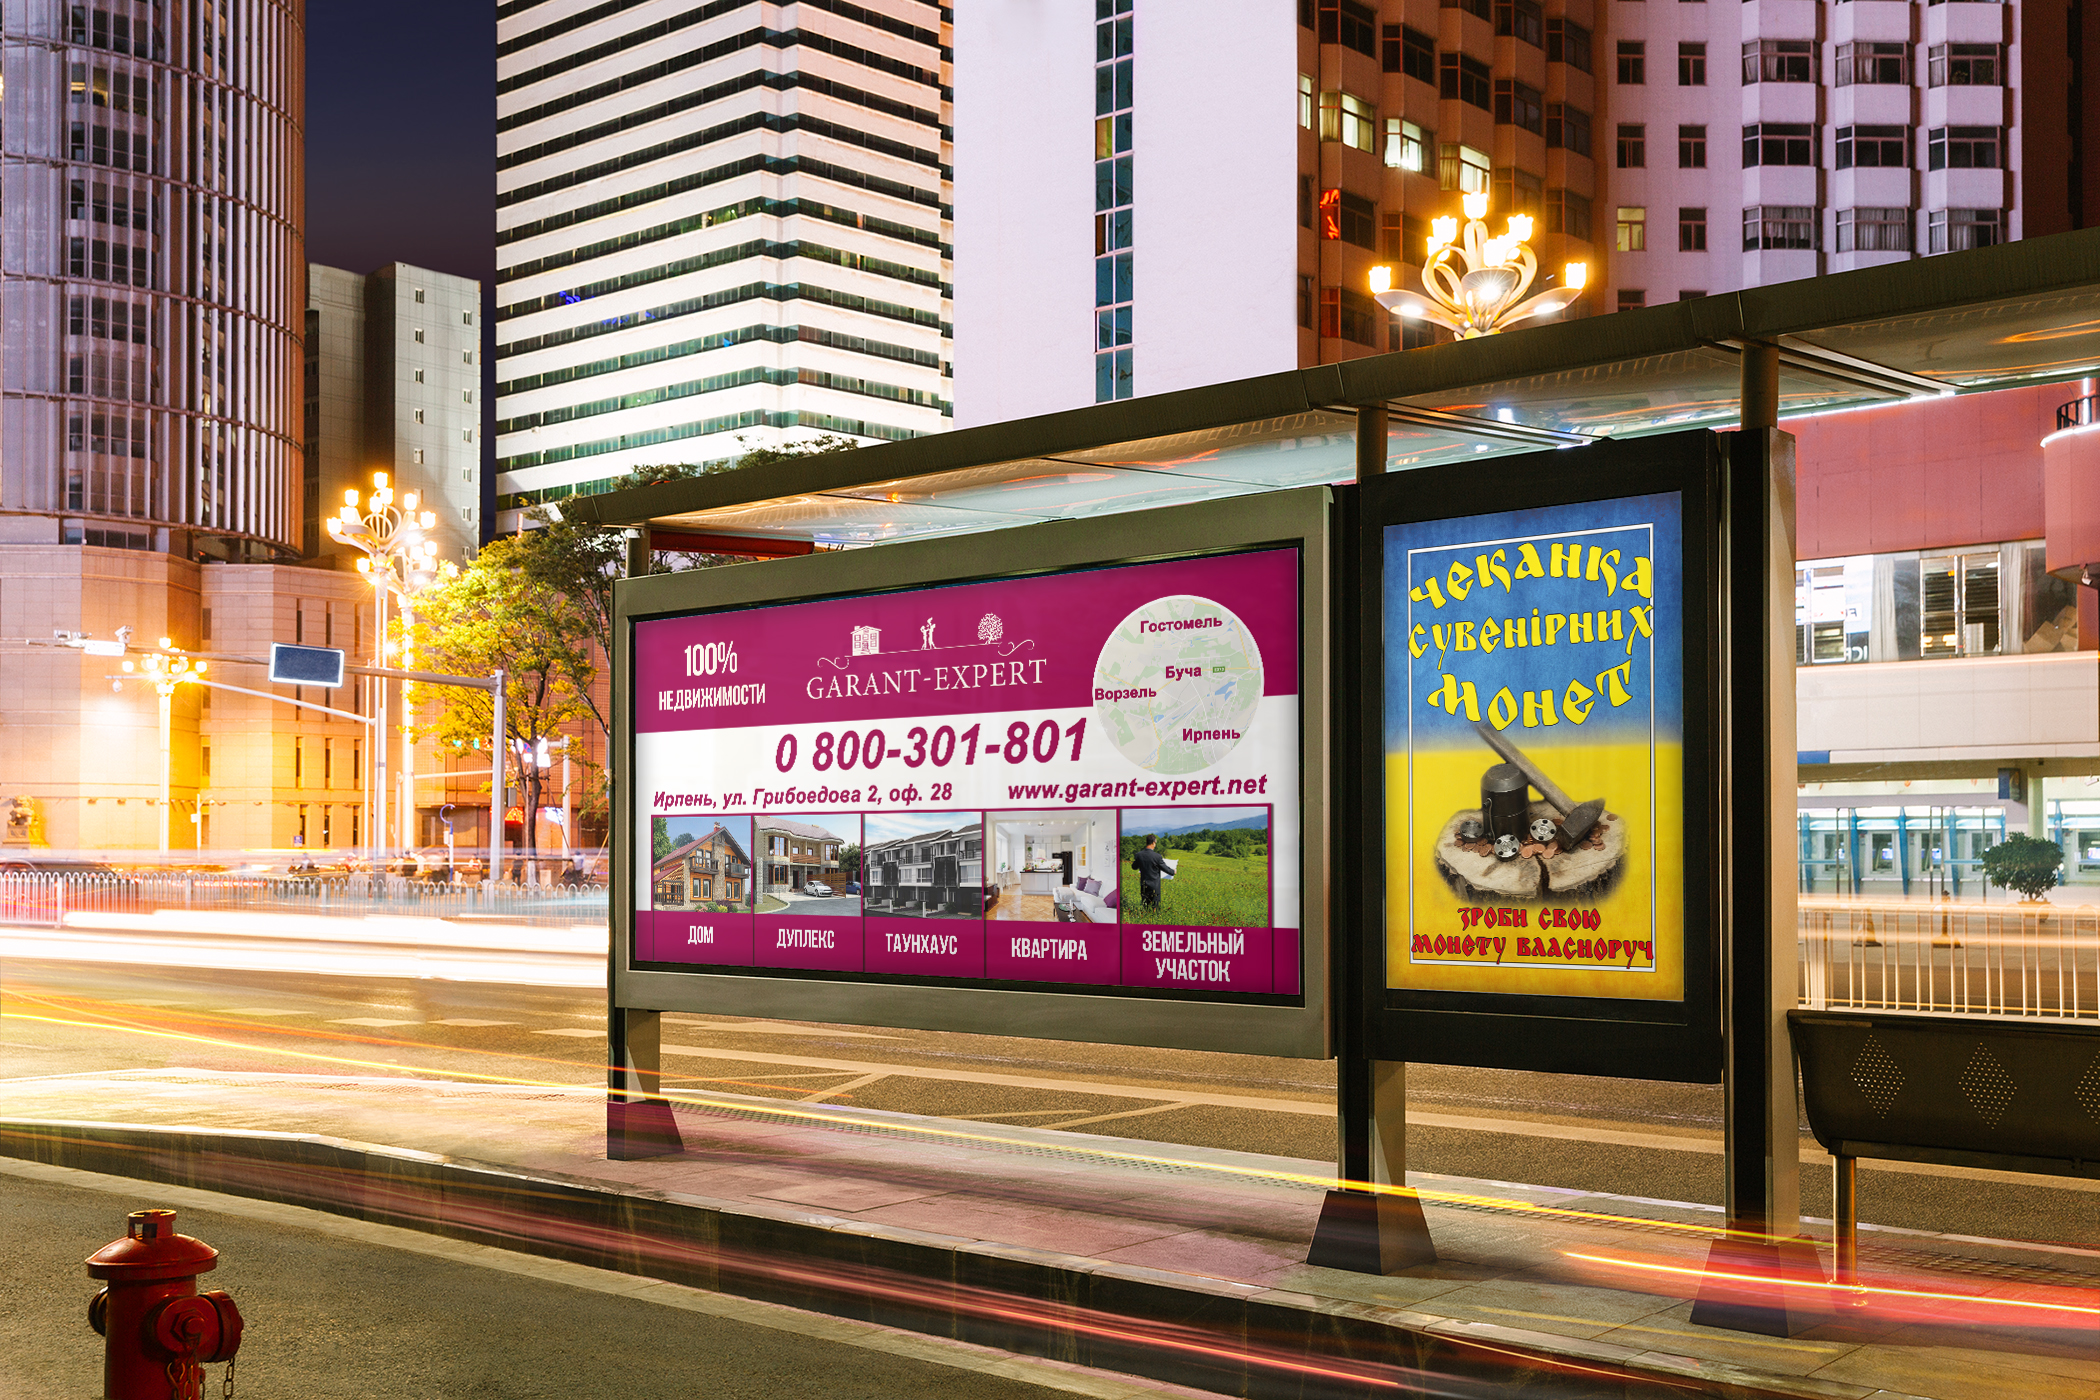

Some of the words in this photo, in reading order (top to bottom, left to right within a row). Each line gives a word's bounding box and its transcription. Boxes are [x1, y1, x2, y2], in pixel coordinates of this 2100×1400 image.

[1140, 617, 1223, 634] Гостомель
[684, 640, 738, 677] 100%
[806, 658, 1047, 700] GARANT-EXPERT
[1165, 665, 1202, 682] Буча
[658, 683, 766, 712] НЕДВИЖИМОСТИ
[1094, 687, 1157, 703] Ворзель
[775, 733, 798, 773] 0
[812, 717, 1087, 772] 800-301-801
[1182, 728, 1241, 744] Ирпень
[653, 791, 717, 811] Ирпень,
[722, 792, 747, 810] ул.
[752, 785, 862, 809] Грибоедова
[867, 784, 882, 806] 2,
[889, 783, 923, 806] оф.
[930, 782, 953, 802] 28
[1008, 774, 1268, 803] www.garant-expert.net
[687, 925, 714, 944] ДОМ
[776, 928, 835, 949] ДУПЛЕКС
[885, 933, 958, 955] ТАУНХАУС
[1142, 928, 1245, 955] ЗЕМЕЛЬНЫЙ
[1011, 937, 1088, 961] КВАРТИРА
[1155, 957, 1231, 982] УЧАСТОК
